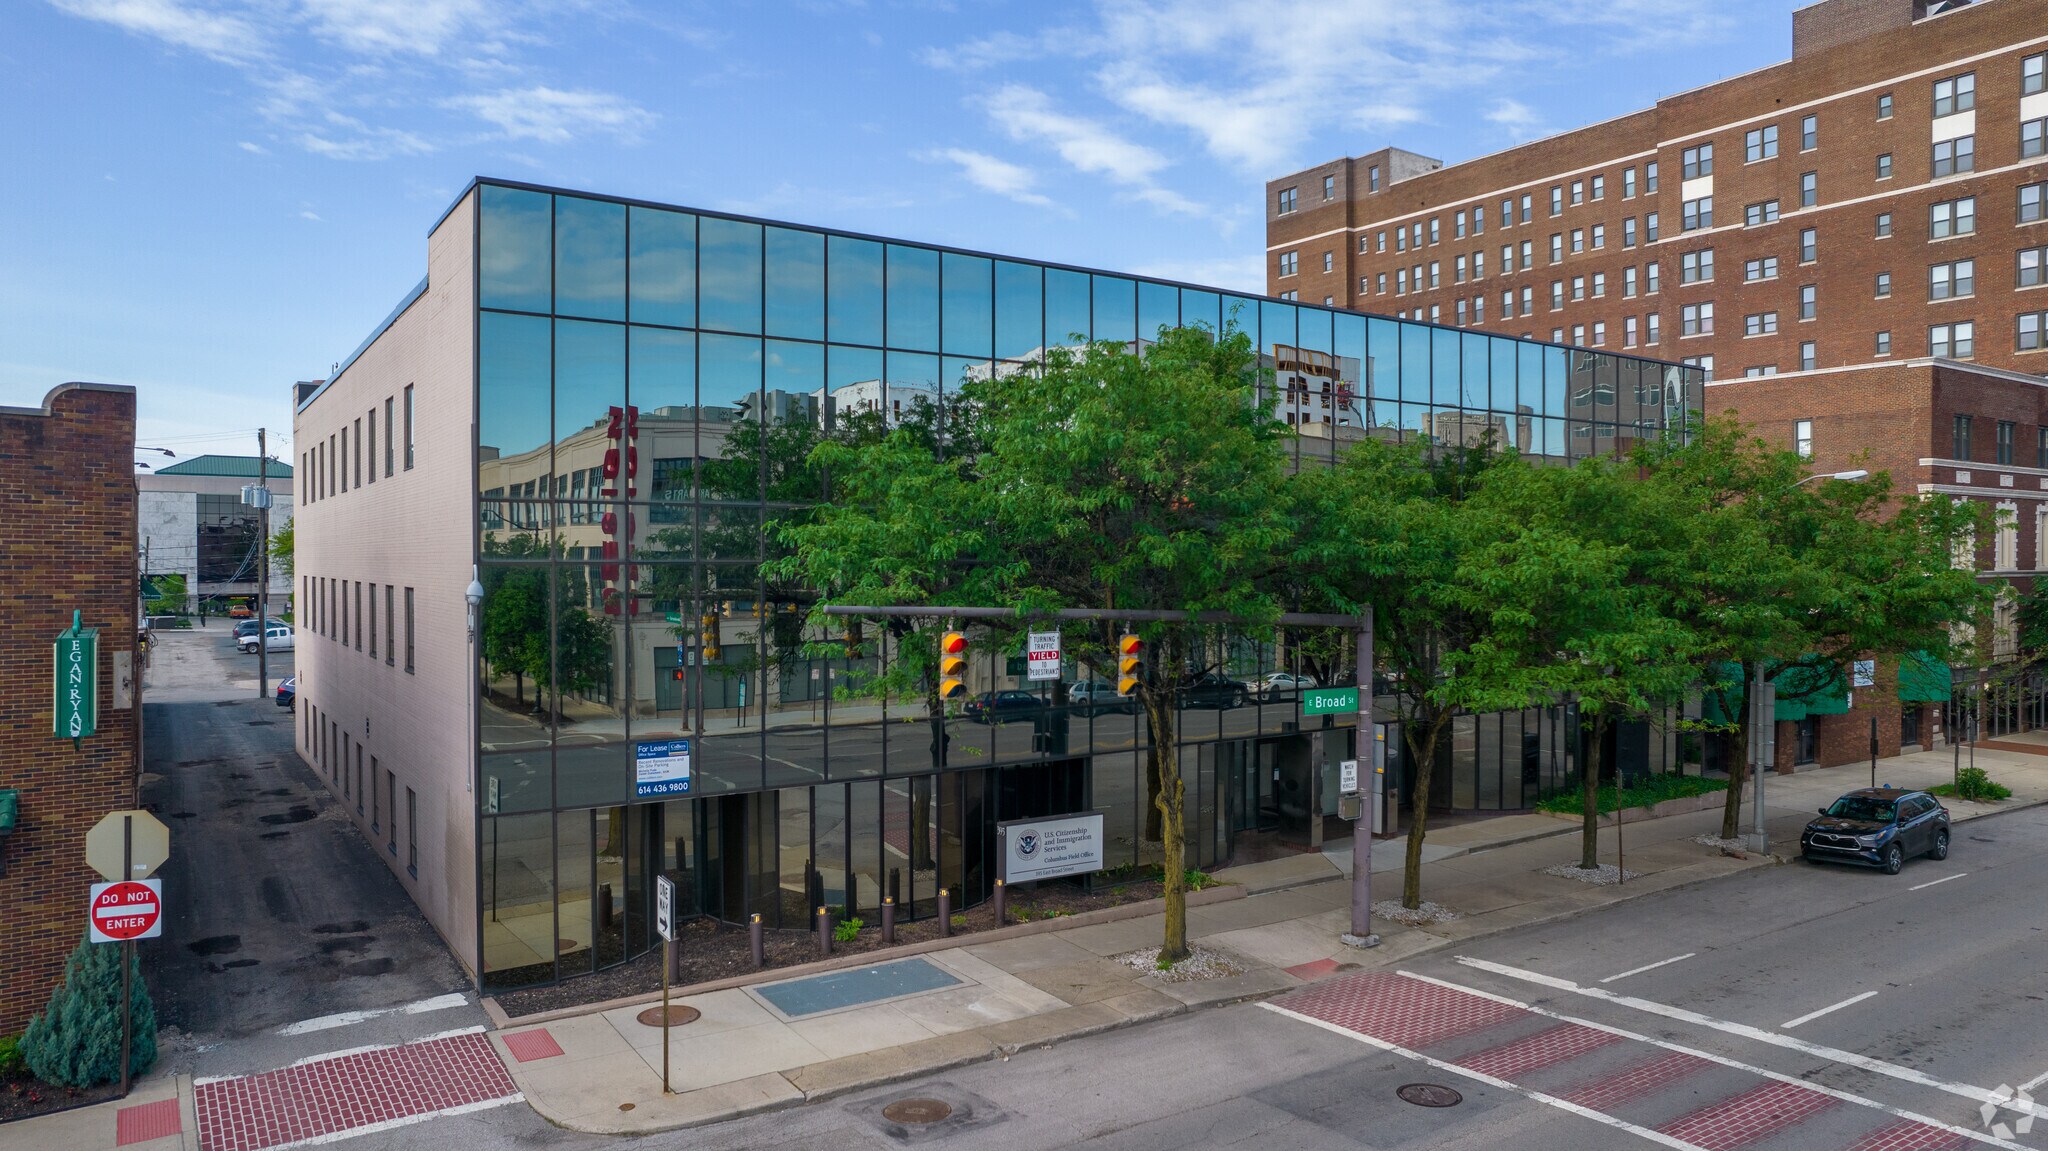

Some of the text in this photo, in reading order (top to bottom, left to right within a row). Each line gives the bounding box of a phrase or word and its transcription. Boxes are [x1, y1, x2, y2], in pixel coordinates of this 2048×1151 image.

[1032, 652, 1057, 660] YIELD
[1030, 668, 1058, 676] PEDESTRIANS
[1316, 695, 1345, 708] Broad
[638, 782, 688, 794] 614 436 9800
[1056, 828, 1087, 837] Citizenship
[1057, 835, 1091, 844] Immigration
[1044, 845, 1067, 853] Services
[660, 883, 668, 900] ONE
[102, 892, 150, 904] DO NOT
[107, 918, 145, 930] ENTER
